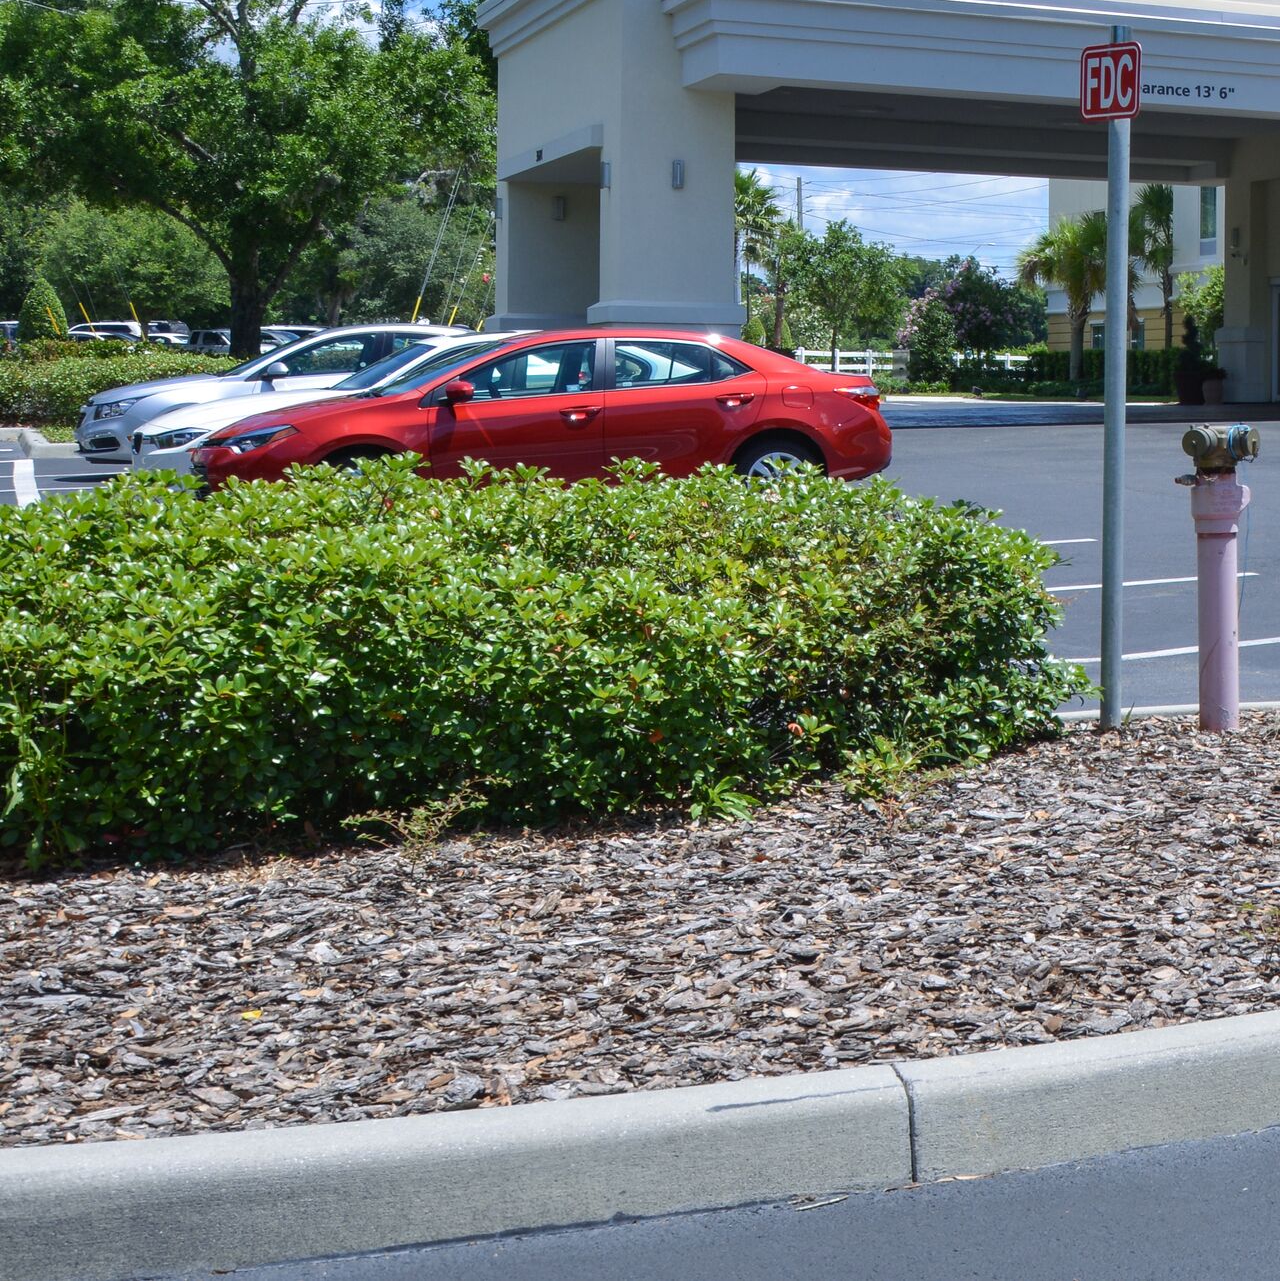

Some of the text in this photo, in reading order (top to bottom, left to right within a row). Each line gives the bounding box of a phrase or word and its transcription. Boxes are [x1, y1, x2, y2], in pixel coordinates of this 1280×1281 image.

[1086, 53, 1133, 110] FDC
[1140, 83, 1235, 100] arance 13' 6"
